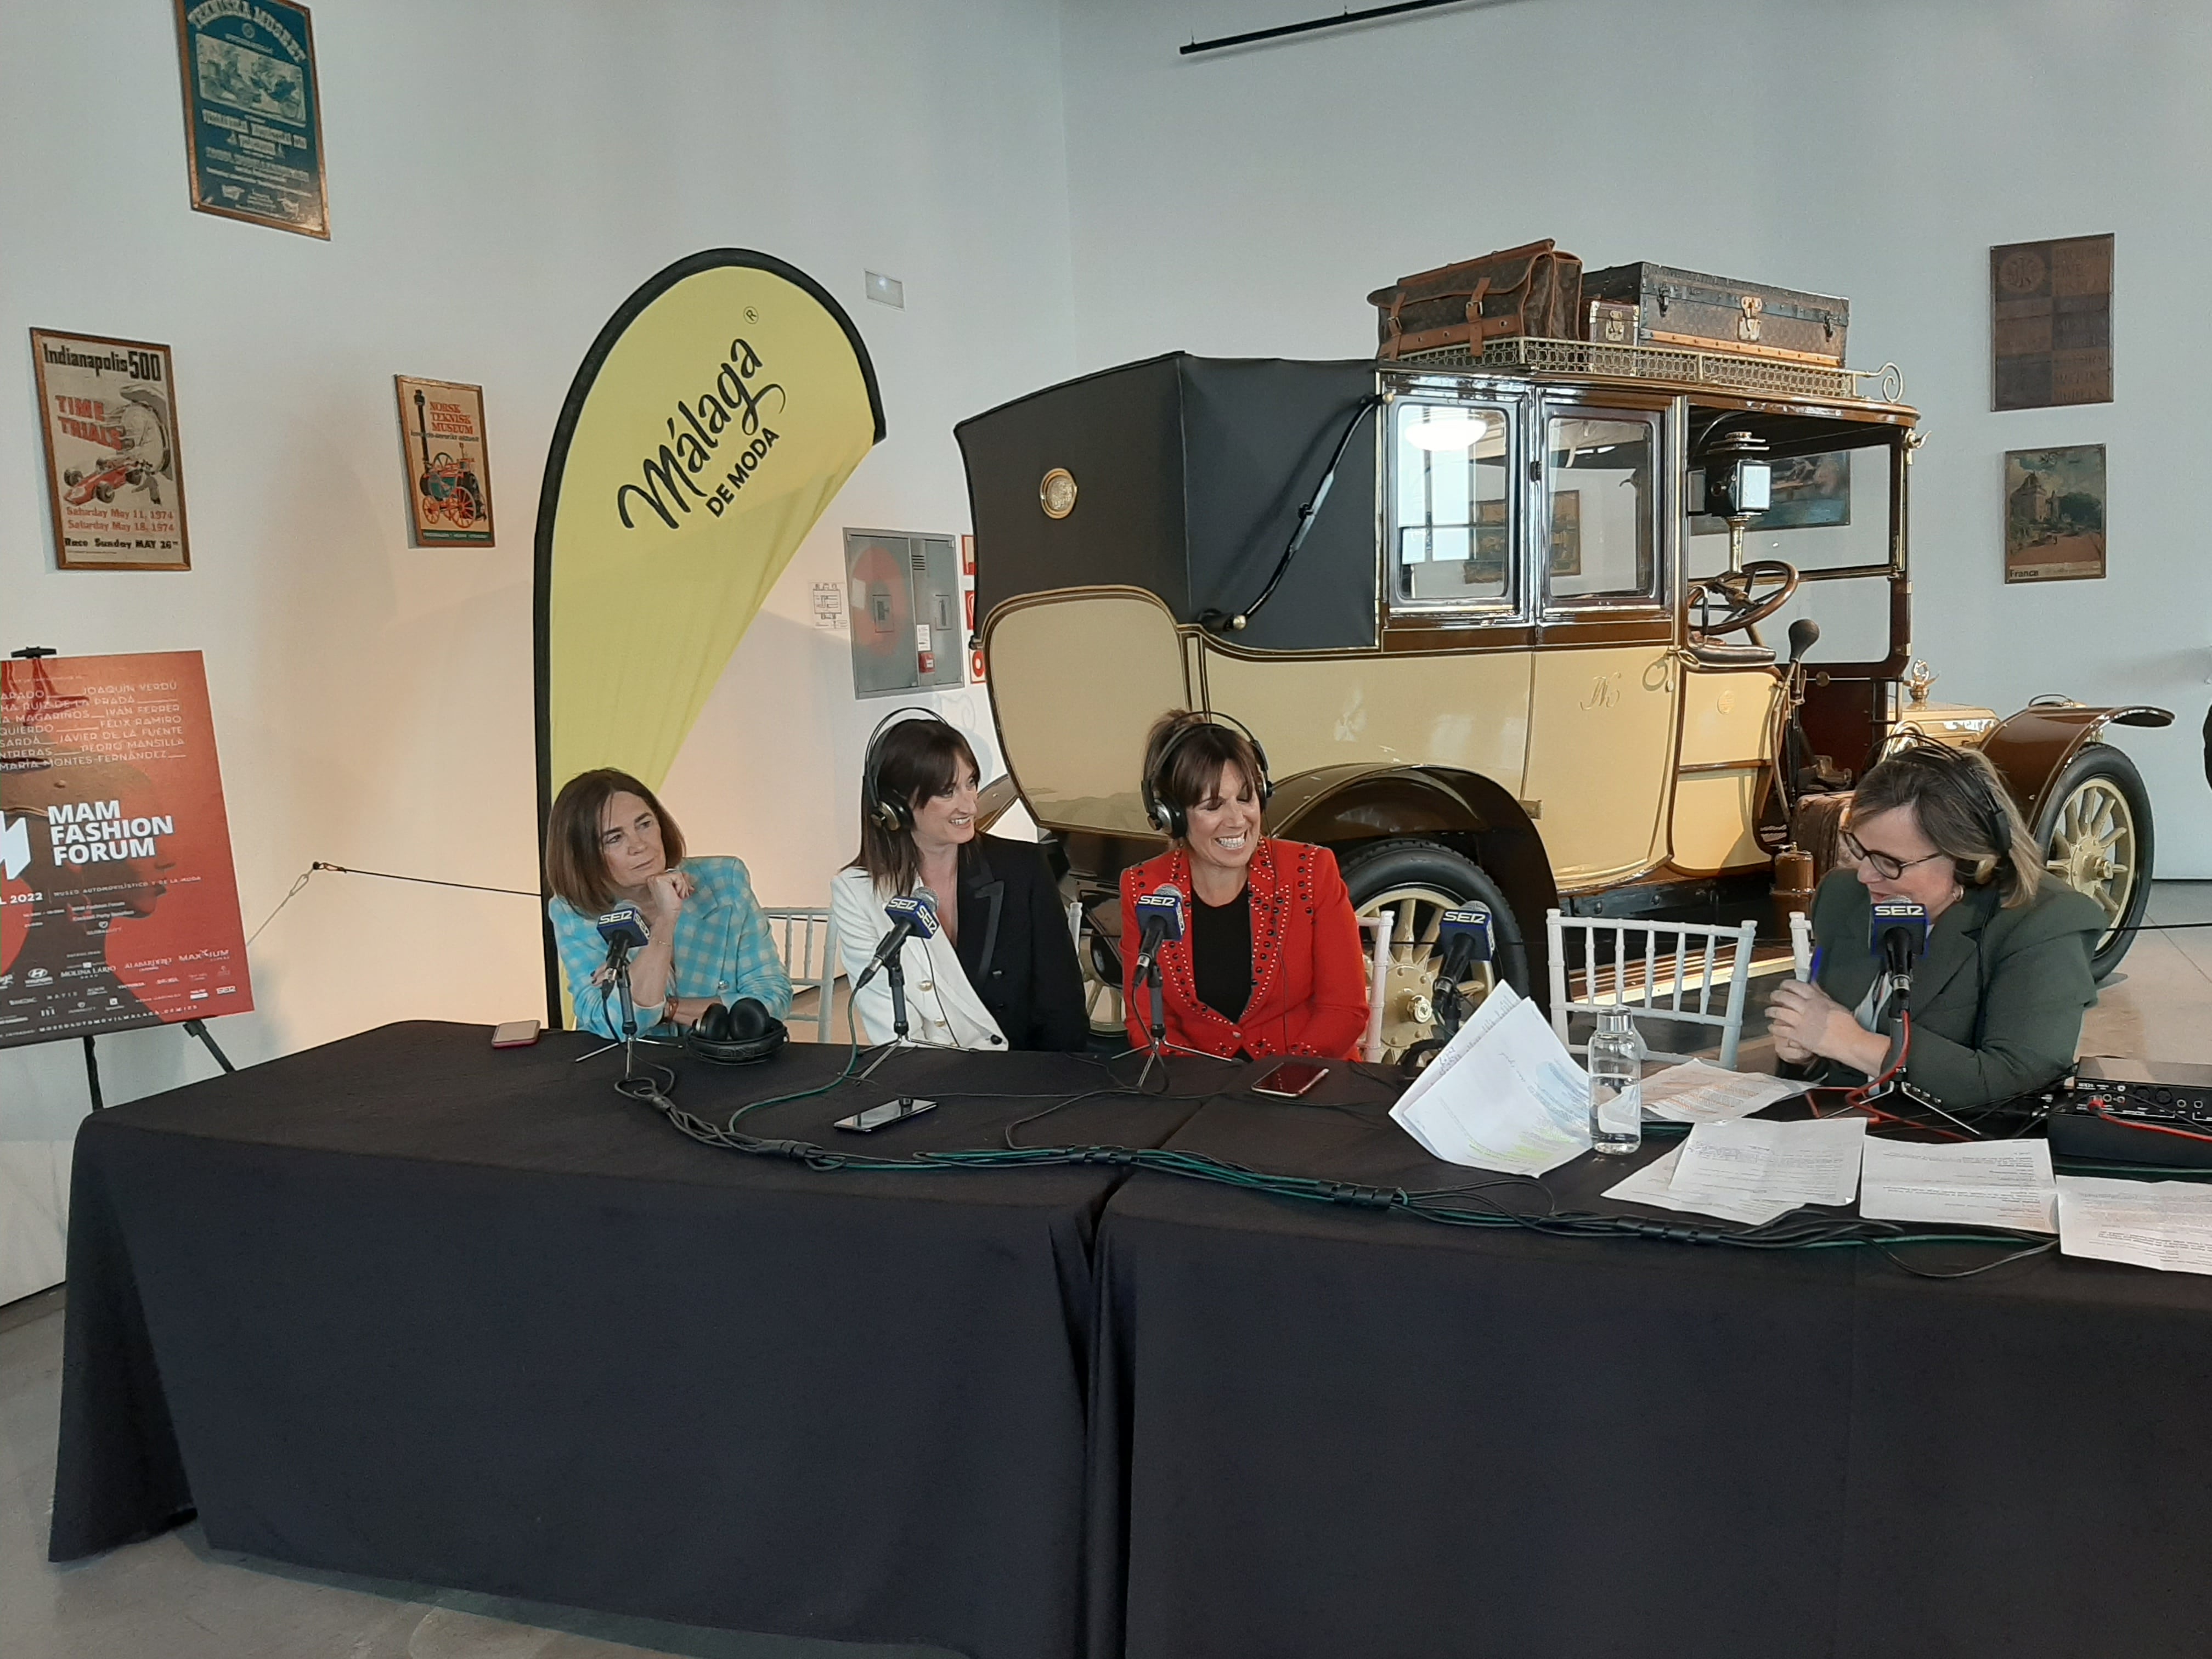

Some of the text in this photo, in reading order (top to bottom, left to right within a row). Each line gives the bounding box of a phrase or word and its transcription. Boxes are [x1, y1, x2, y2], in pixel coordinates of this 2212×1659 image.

[43, 343, 162, 381] Indianapolis 500
[55, 395, 105, 422] TIME
[430, 402, 461, 413] NORSK
[431, 412, 471, 424] TEKNISK
[58, 416, 123, 450] TRIALS
[432, 422, 473, 435] MUSEUM
[617, 338, 786, 529] Málaga
[706, 427, 780, 517] DE MODA
[66, 506, 108, 518] Saturday
[111, 509, 129, 520] May
[150, 510, 173, 520] 1974
[68, 520, 109, 532] Saturday
[112, 522, 131, 532] May
[152, 523, 174, 532] 1974
[65, 538, 88, 547] Race
[94, 538, 132, 549] Sunday
[136, 540, 156, 549] MAY
[23, 701, 51, 711] RUIZ
[138, 704, 179, 714] FERRER
[136, 715, 182, 725] RAMIRO
[60, 733, 97, 743] JAVIER
[103, 732, 121, 740] DE
[123, 729, 137, 738] LA
[142, 726, 183, 737] FUENTE
[80, 742, 122, 752] PEDRO
[128, 738, 185, 749] MANSILLA
[48, 800, 121, 825] MAM
[50, 815, 174, 845] FASHION
[53, 837, 155, 866] FORUM
[10, 892, 43, 904] 2022
[888, 898, 918, 910] SER
[1138, 895, 1175, 906] SER
[599, 910, 632, 924] SER
[1874, 905, 1925, 916] SER
[1442, 911, 1486, 924] SER
[60, 969, 92, 978] MOLINA
